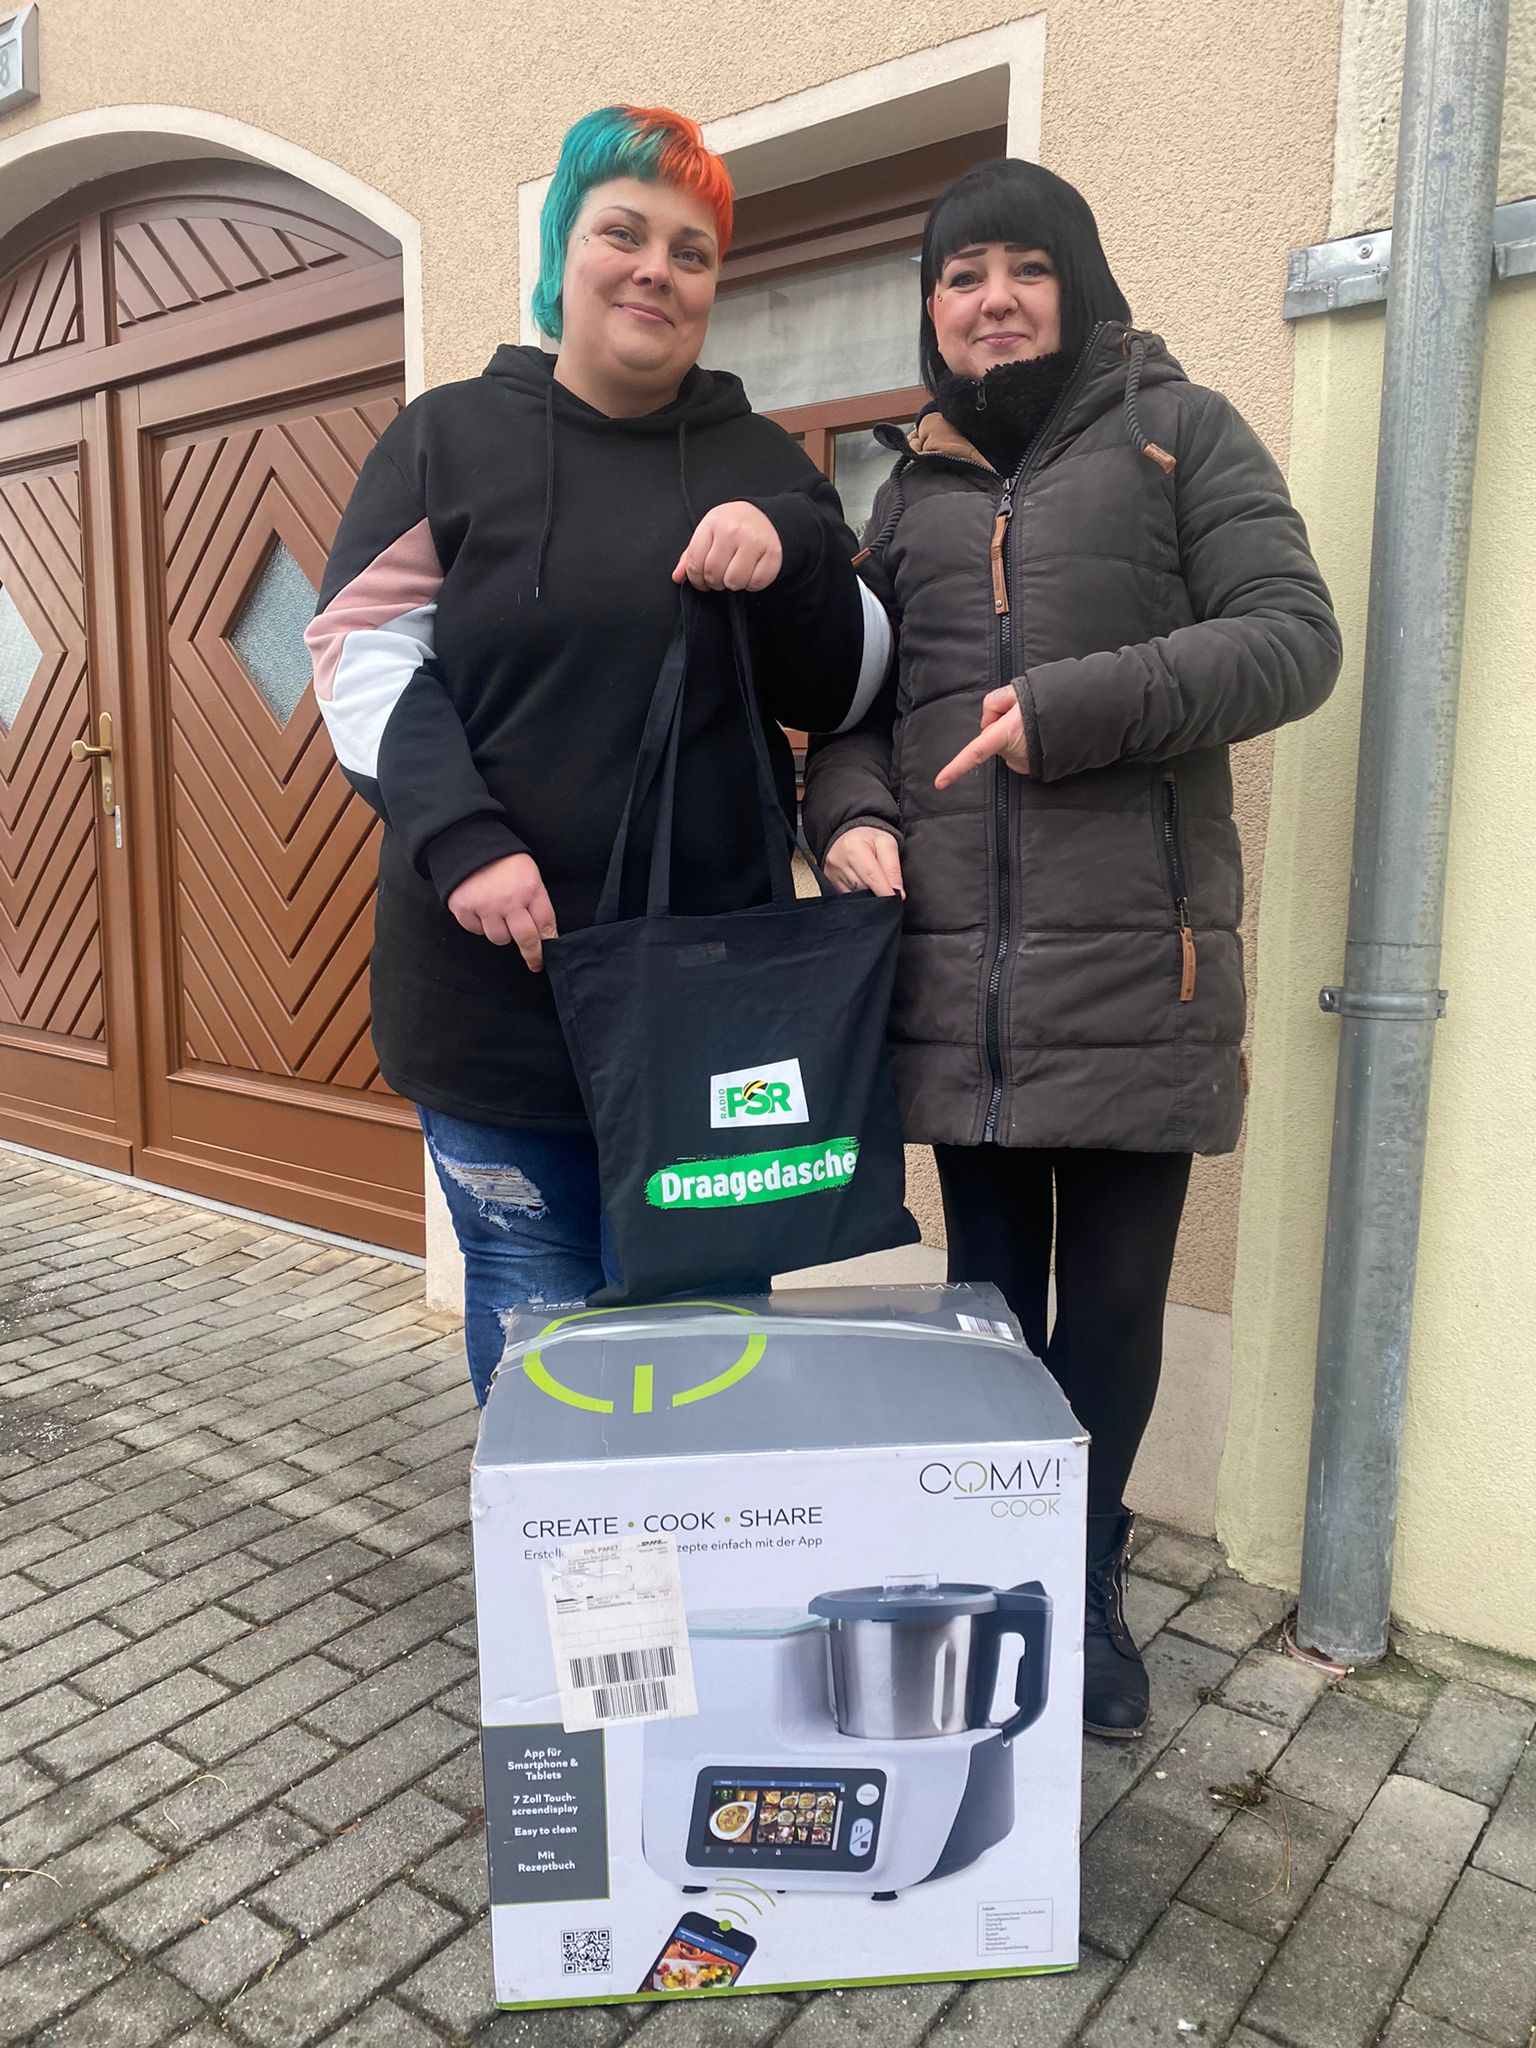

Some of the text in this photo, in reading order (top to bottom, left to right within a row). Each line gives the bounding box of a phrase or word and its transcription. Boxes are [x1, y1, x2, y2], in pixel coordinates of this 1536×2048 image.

[718, 1088, 727, 1119] RADIO
[726, 1080, 793, 1118] PSR
[661, 1149, 856, 1203] Draagedasche
[990, 1498, 1061, 1519] COOK
[522, 1506, 823, 1539] CREATE COOK SHARE
[523, 1547, 564, 1560] Erstell
[676, 1541, 709, 1554] zepte
[711, 1538, 752, 1551] einfach
[755, 1537, 774, 1549] mit
[776, 1536, 796, 1548] der
[798, 1535, 823, 1548] App
[524, 1747, 562, 1760] App für
[507, 1758, 579, 1771] Smartphone &
[525, 1770, 562, 1781] Tablets
[513, 1792, 576, 1805] 7 Zoll Touch-
[511, 1803, 578, 1816] screendisplay
[514, 1824, 577, 1838] Easy to clean
[537, 1850, 555, 1860] Mit
[518, 1860, 576, 1873] Rezeptbuch
